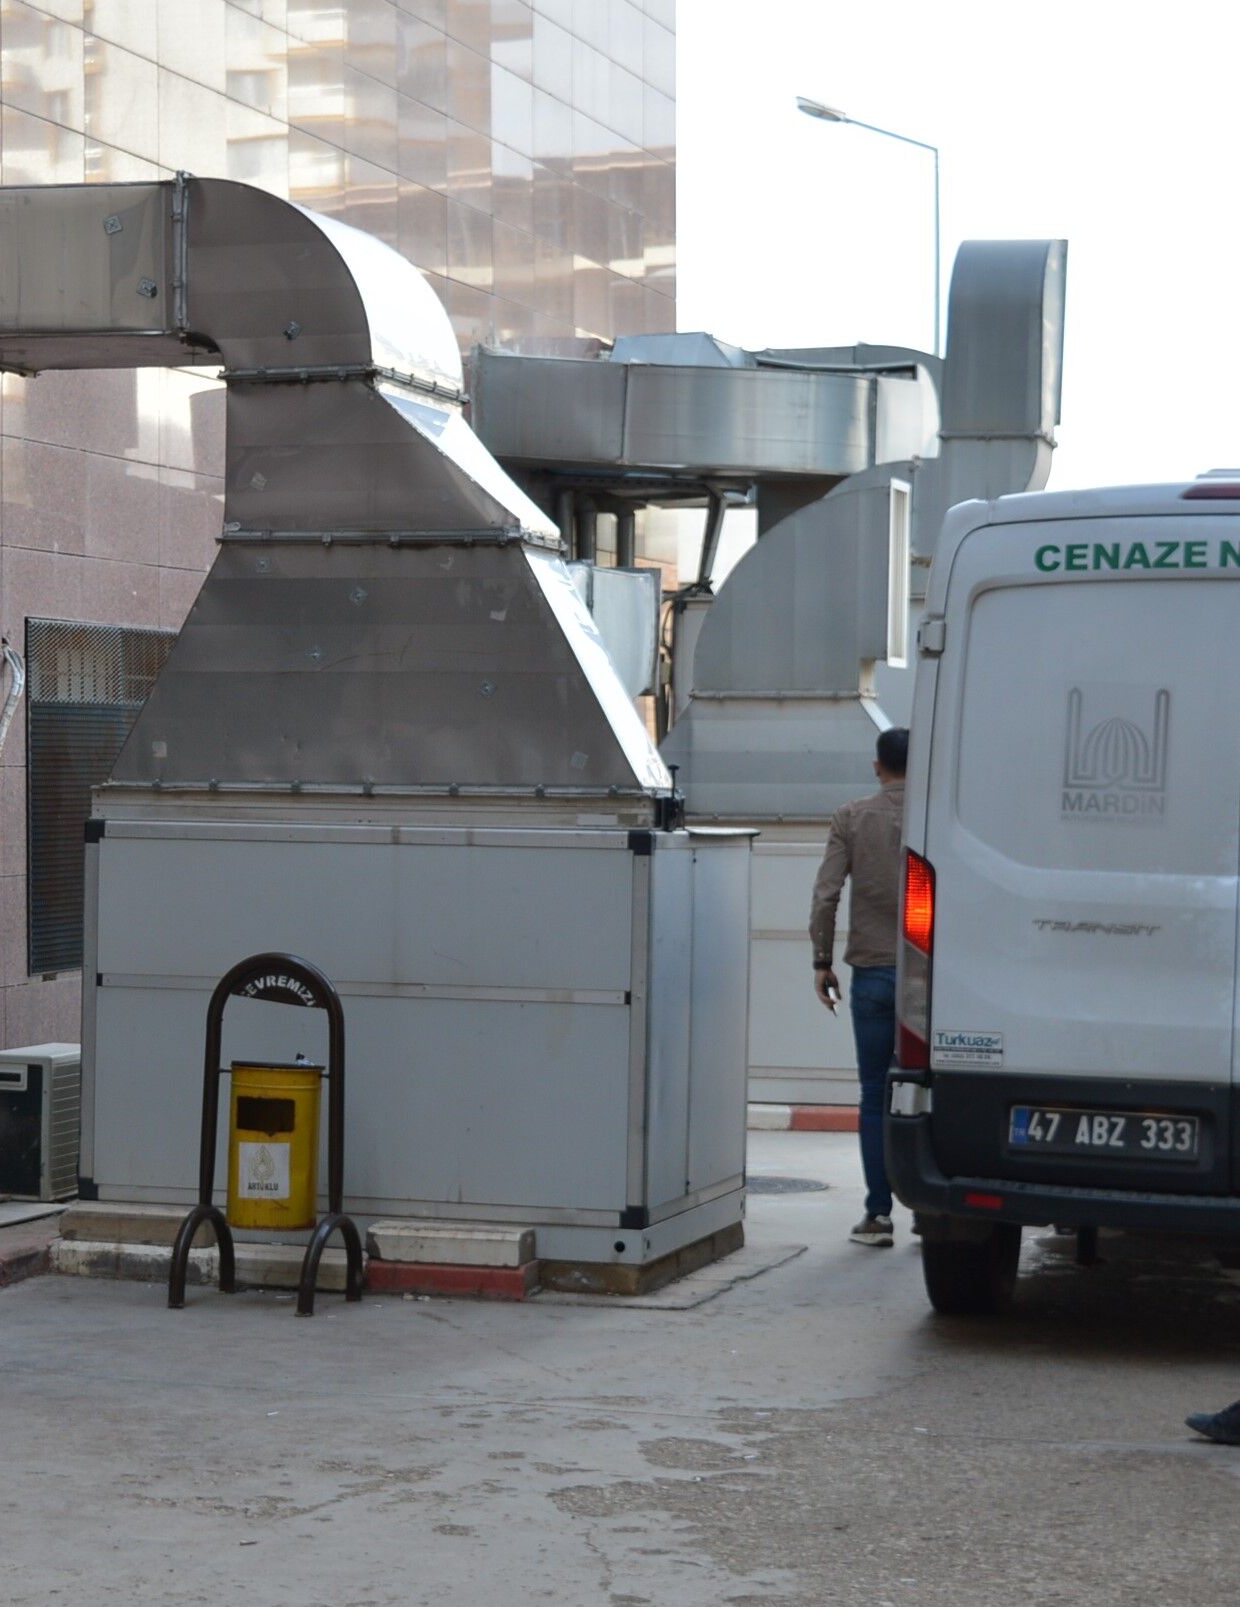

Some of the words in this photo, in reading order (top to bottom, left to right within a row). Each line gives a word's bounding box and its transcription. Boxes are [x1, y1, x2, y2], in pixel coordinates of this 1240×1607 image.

[1034, 541, 1208, 572] CENAZE
[1027, 1111, 1061, 1142] 47
[1075, 1115, 1126, 1147] ABZ
[1140, 1119, 1192, 1151] 333
